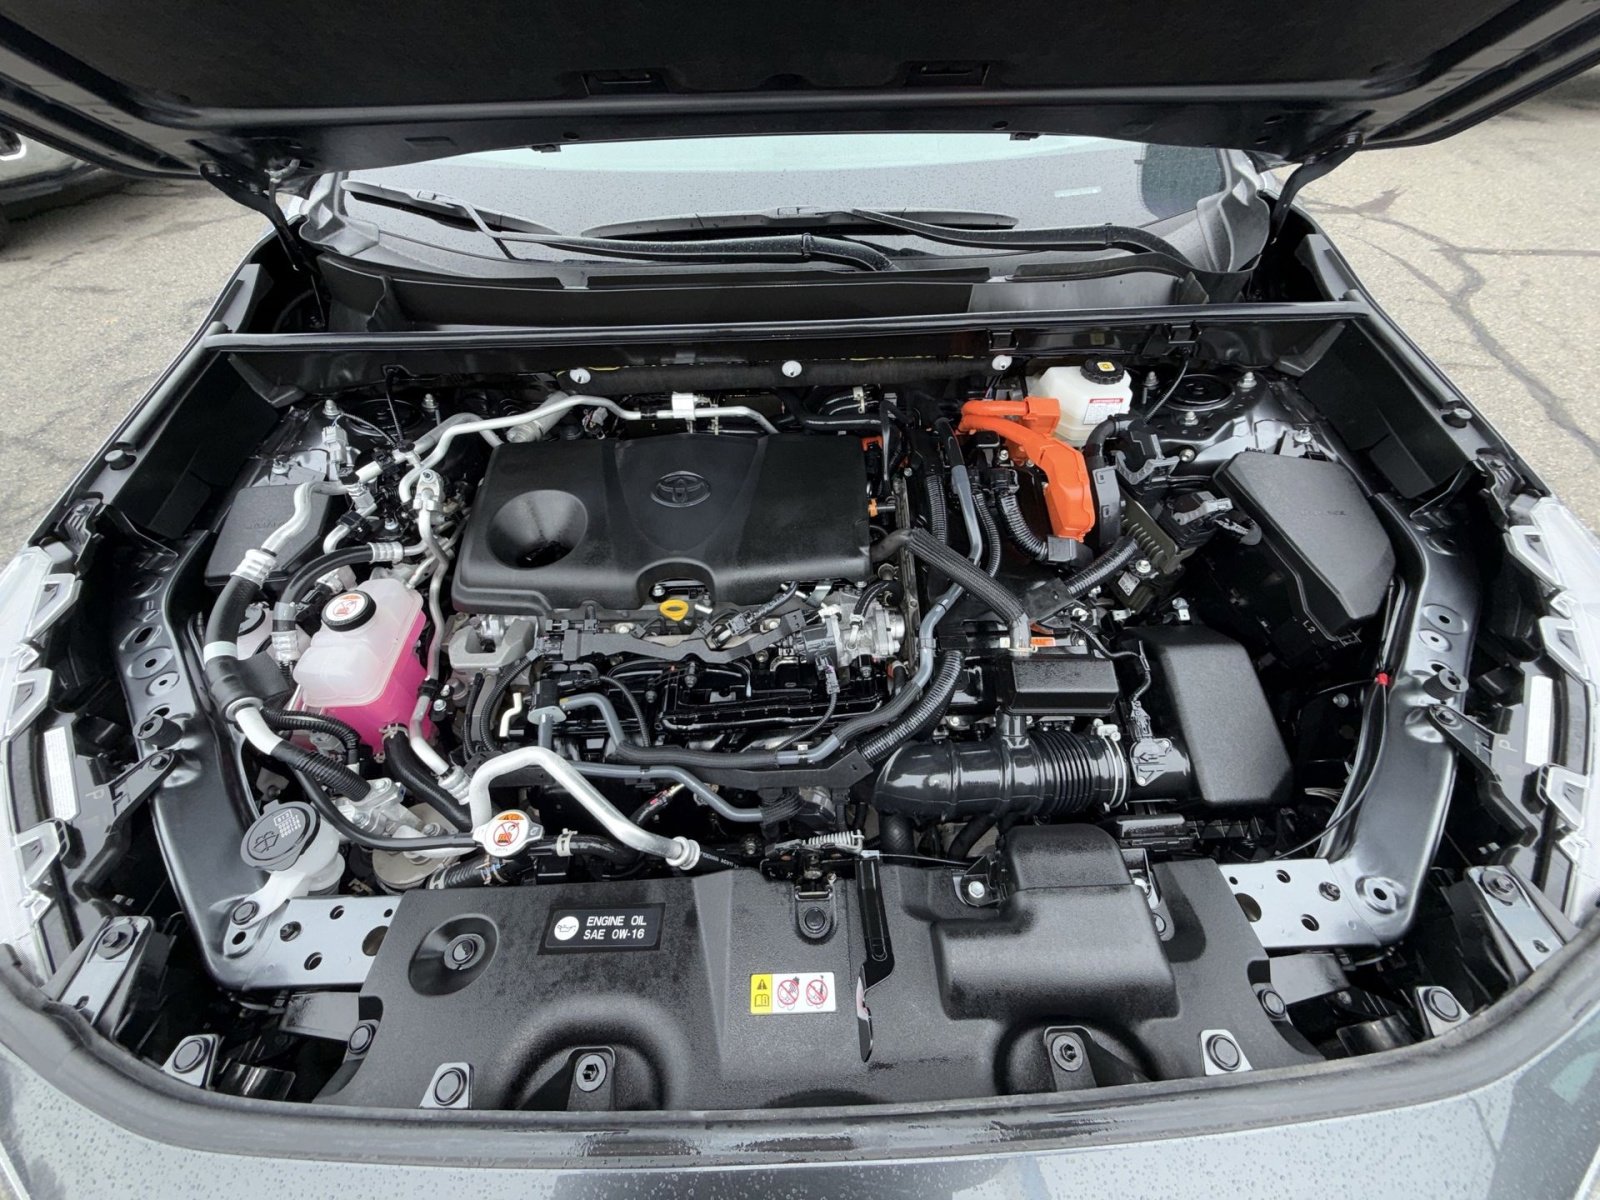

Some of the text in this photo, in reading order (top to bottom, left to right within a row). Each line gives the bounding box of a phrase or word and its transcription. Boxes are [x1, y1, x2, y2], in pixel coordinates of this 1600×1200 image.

[586, 915, 647, 926] ENGINE OIL
[583, 928, 645, 940] SAE 0W-16
